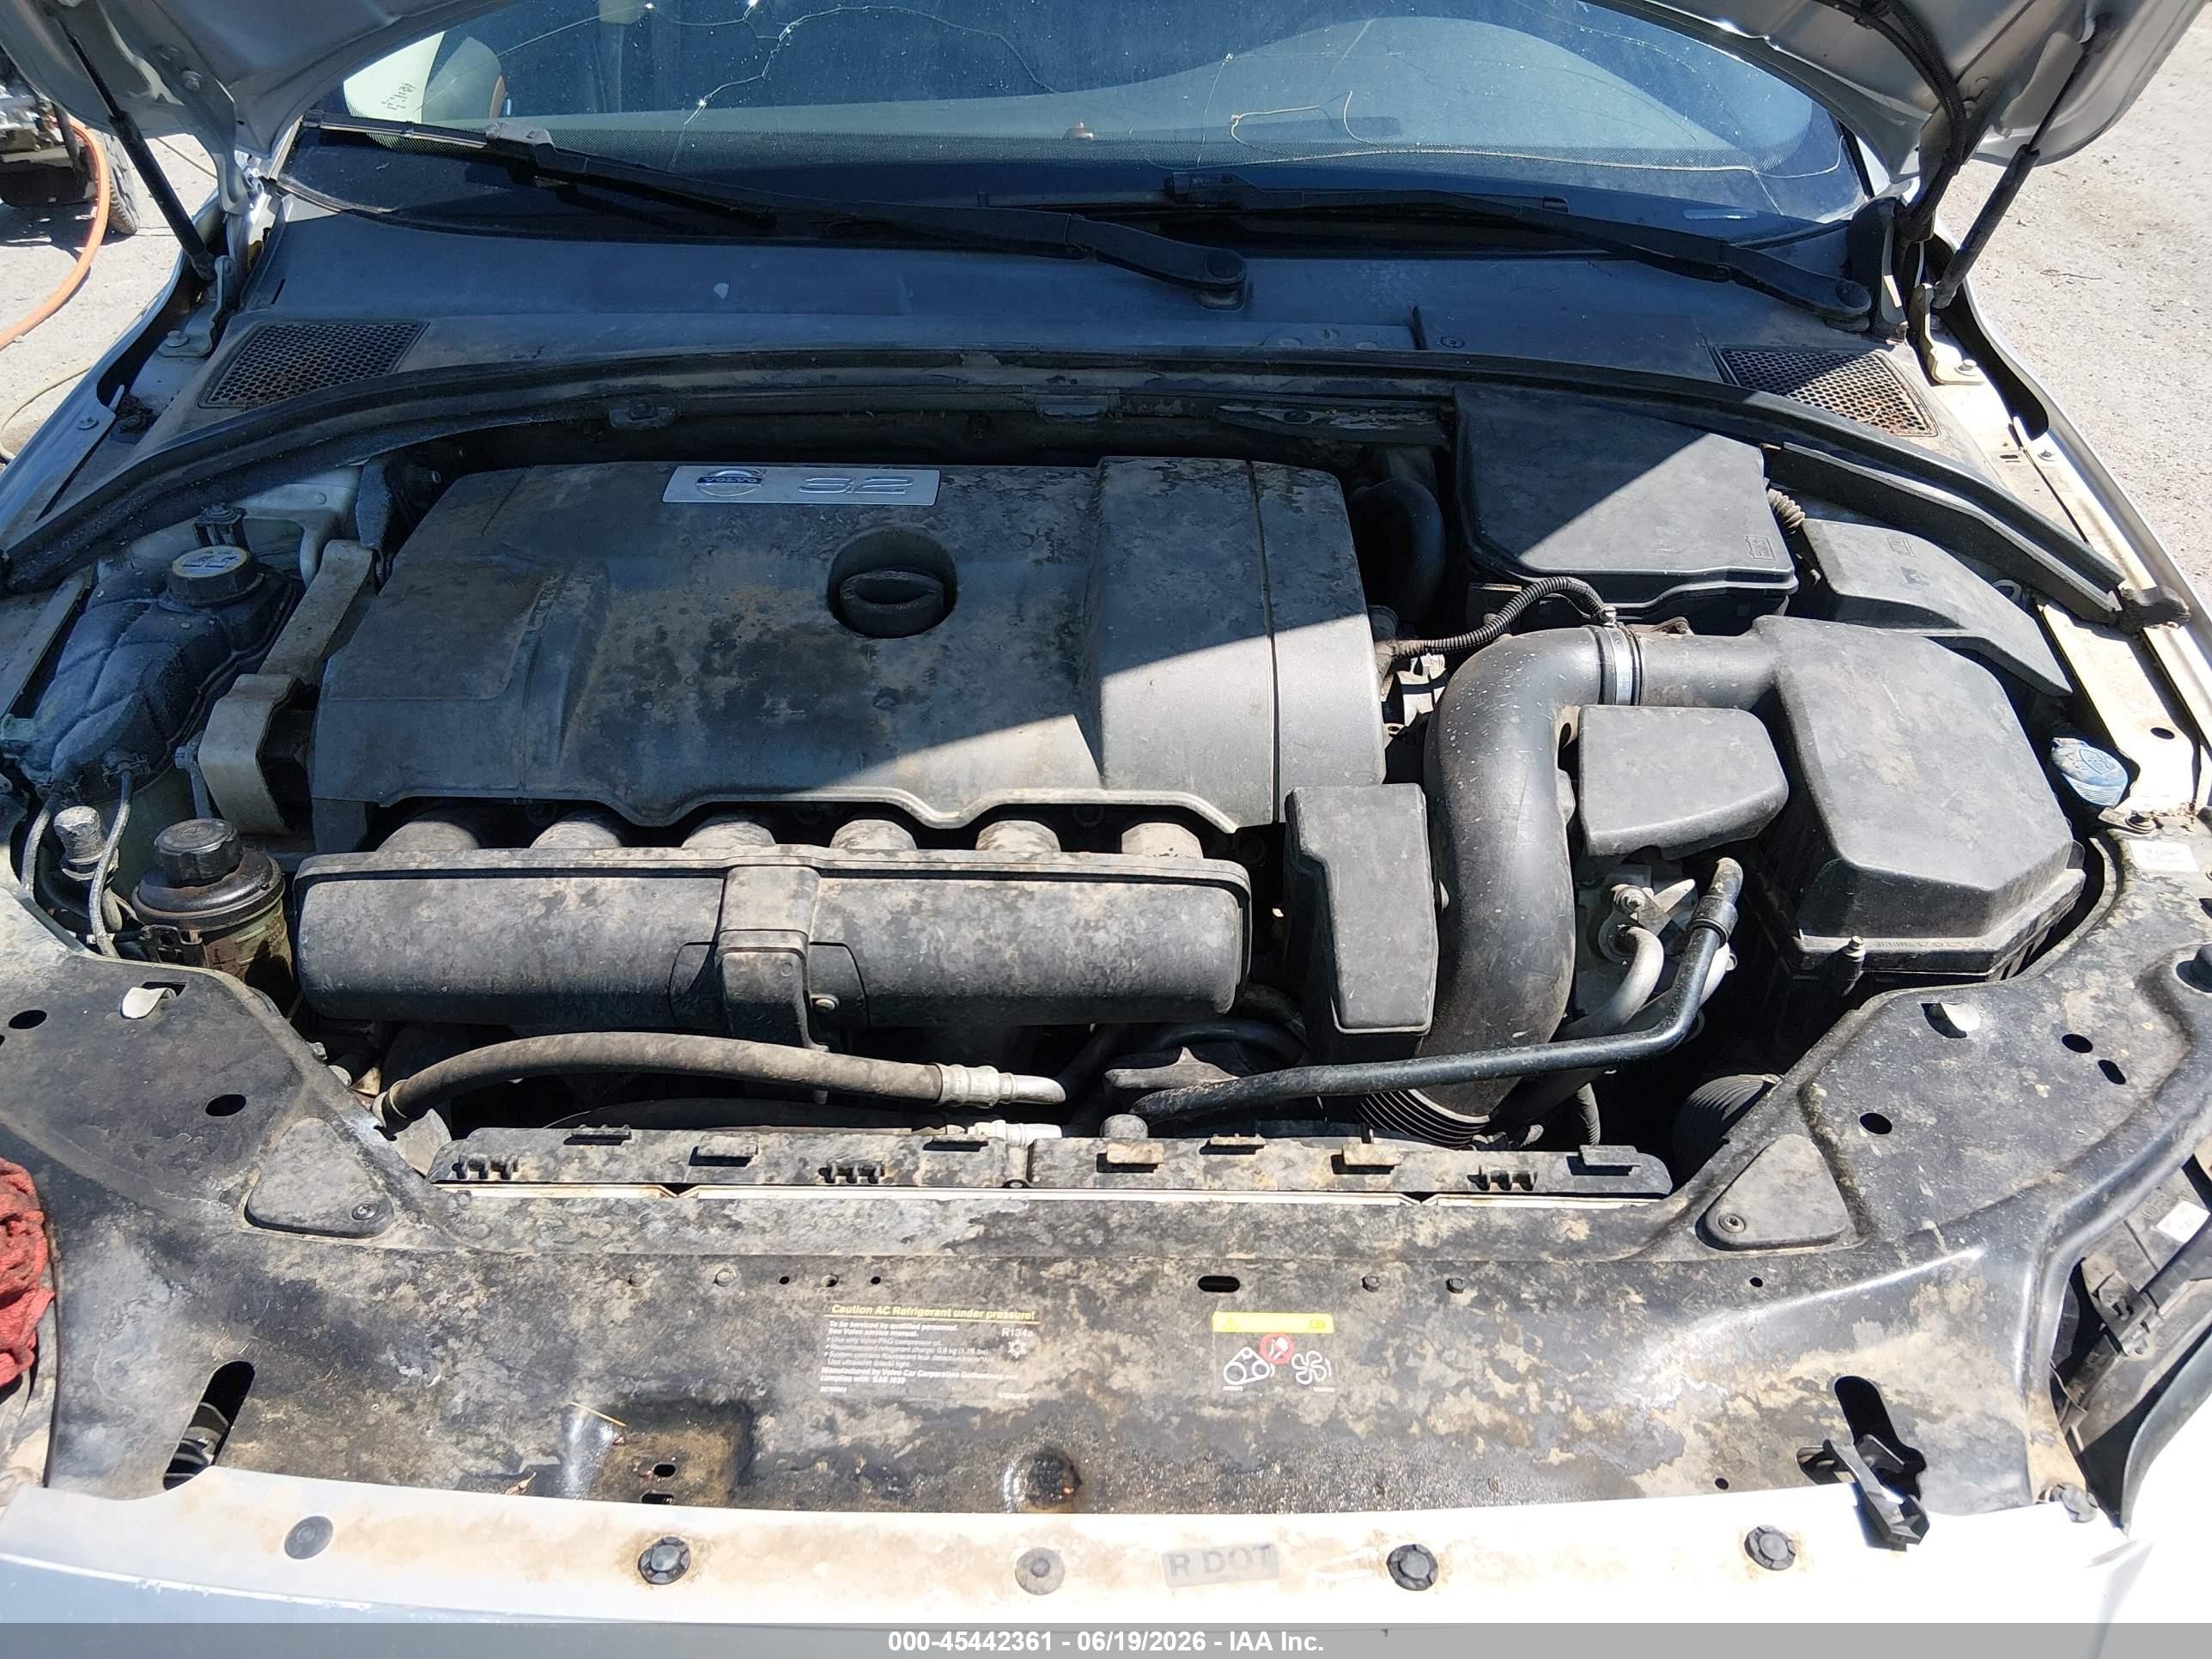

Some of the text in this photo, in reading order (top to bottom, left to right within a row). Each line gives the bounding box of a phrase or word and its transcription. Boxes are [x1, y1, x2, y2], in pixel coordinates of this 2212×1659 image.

[831, 1304, 1036, 1321] Caution AC Refrigerant under pressure!
[1001, 1327, 1035, 1338] R134a
[1201, 1543, 1273, 1574] DOT
